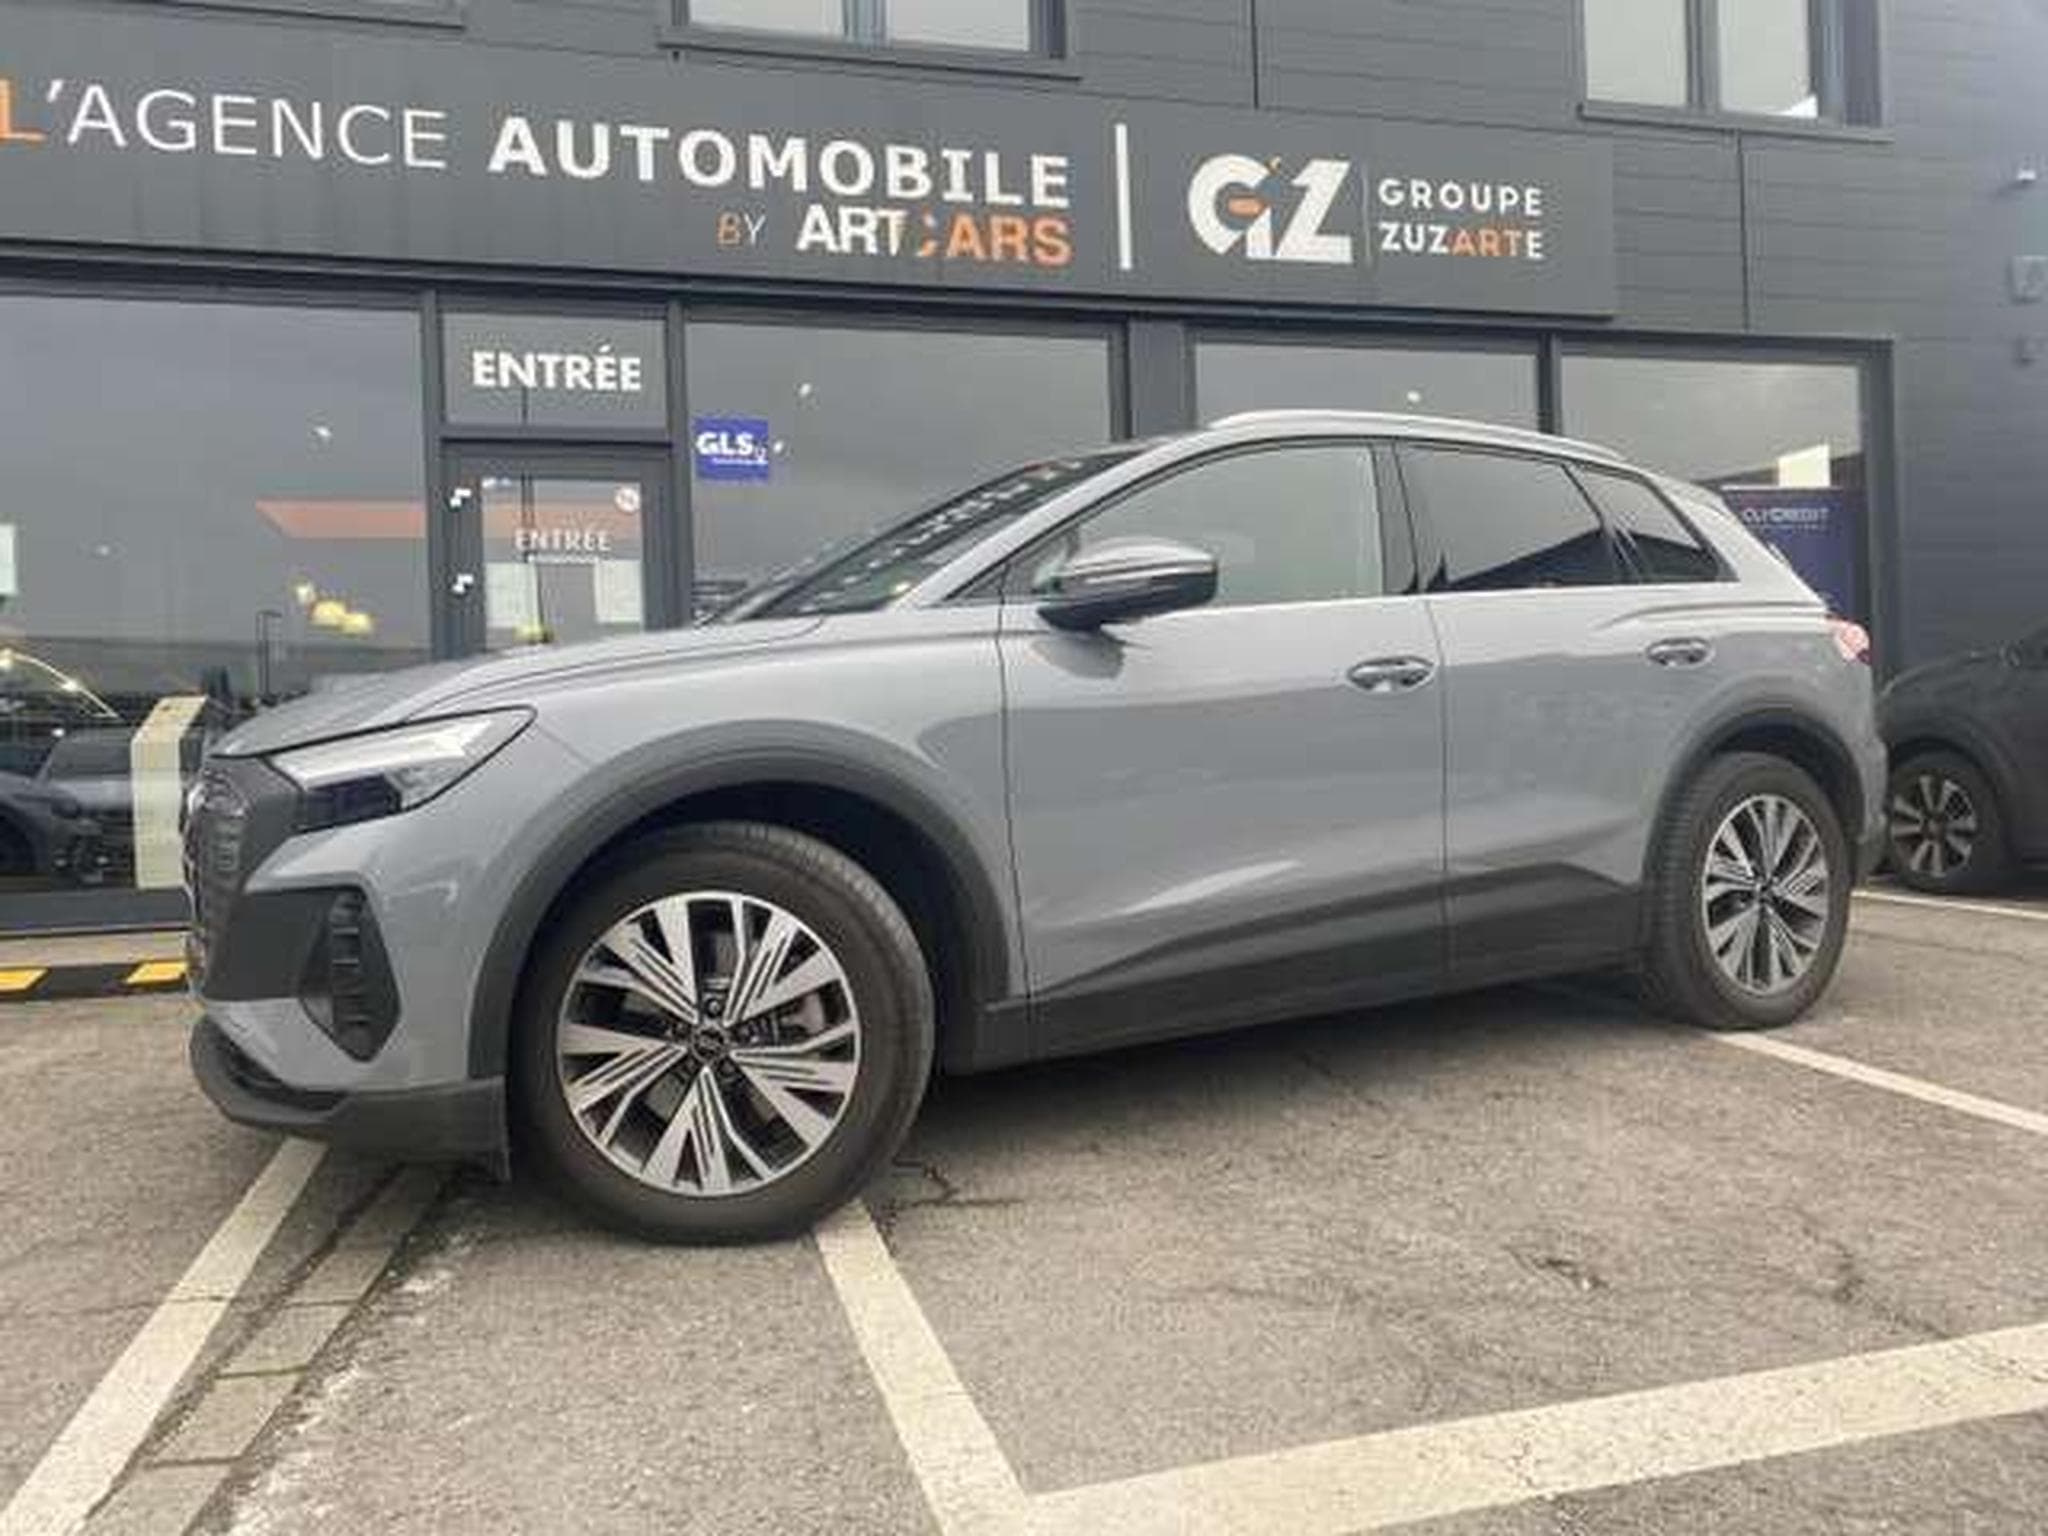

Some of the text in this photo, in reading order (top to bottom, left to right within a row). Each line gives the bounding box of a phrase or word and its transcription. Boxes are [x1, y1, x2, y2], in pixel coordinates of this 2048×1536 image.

[0, 79, 1071, 208] L'AGENCE AUTOMOBILE
[1378, 178, 1543, 217] GROUPE
[717, 212, 767, 246] BY
[1378, 220, 1544, 261] ZUZARTE
[471, 343, 642, 392] ENTRÉE
